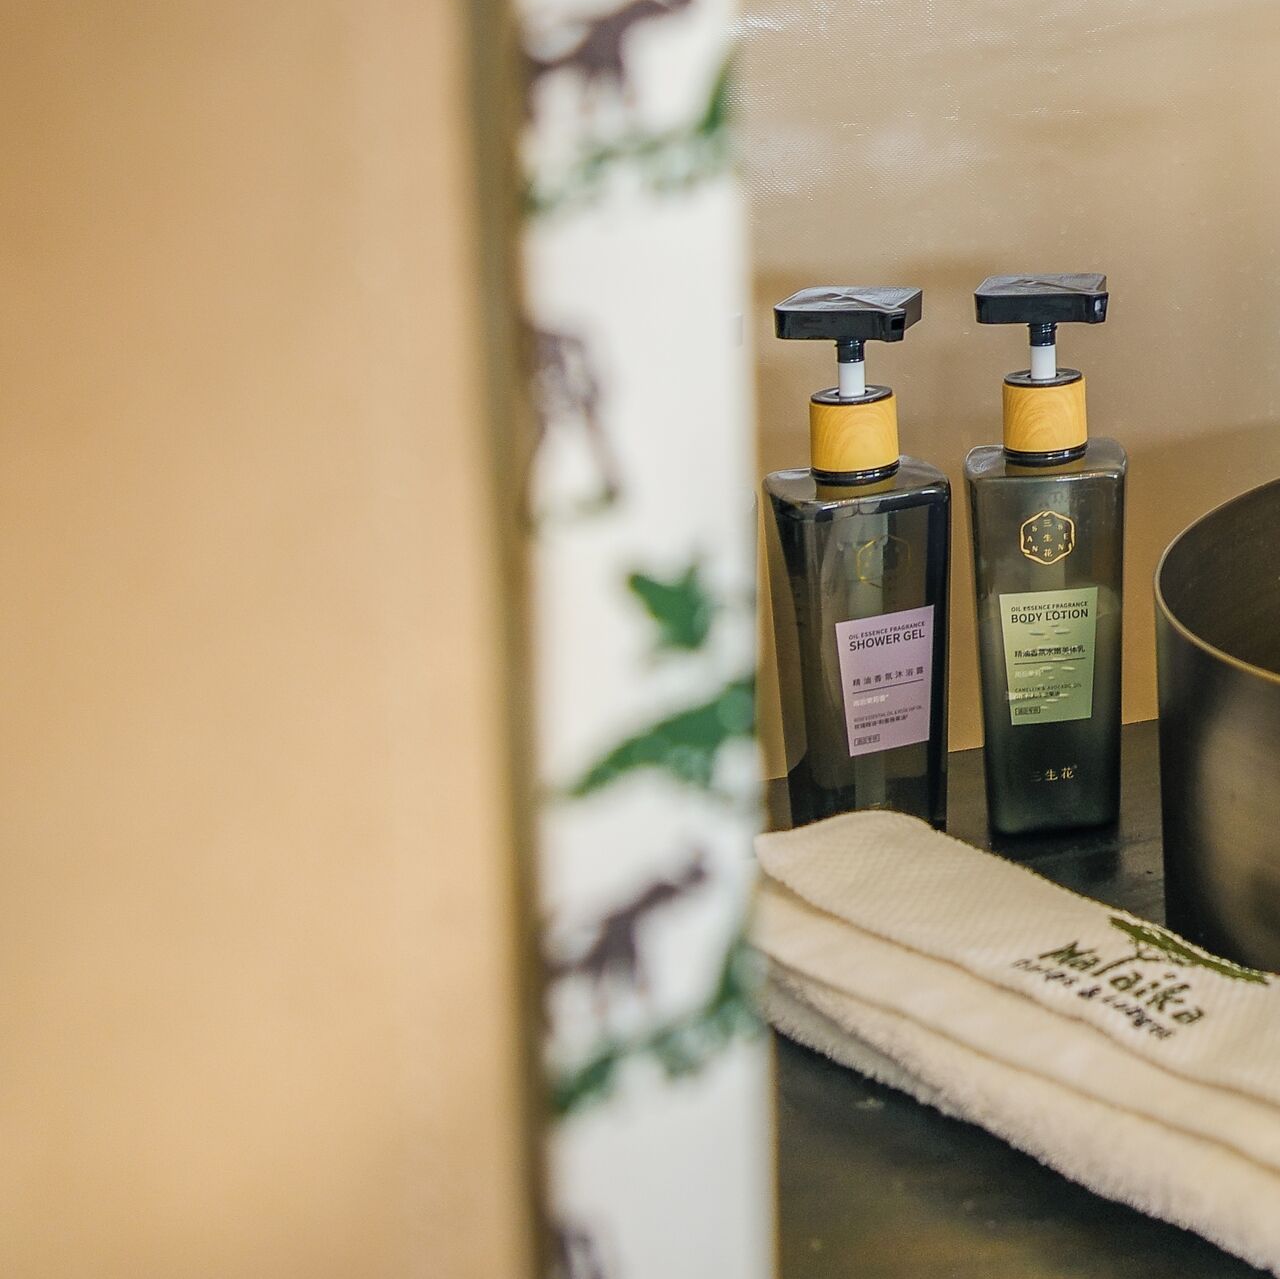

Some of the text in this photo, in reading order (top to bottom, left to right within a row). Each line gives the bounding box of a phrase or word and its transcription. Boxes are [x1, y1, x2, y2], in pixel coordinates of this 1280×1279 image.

[1052, 601, 1088, 610] FRAGRANCE
[1011, 608, 1088, 624] BODY LOTION
[860, 628, 888, 638] ESSENCE
[889, 621, 926, 632] FRAGRANCE
[849, 628, 925, 652] SHOWER GEL
[1037, 940, 1205, 1025] Malaika
